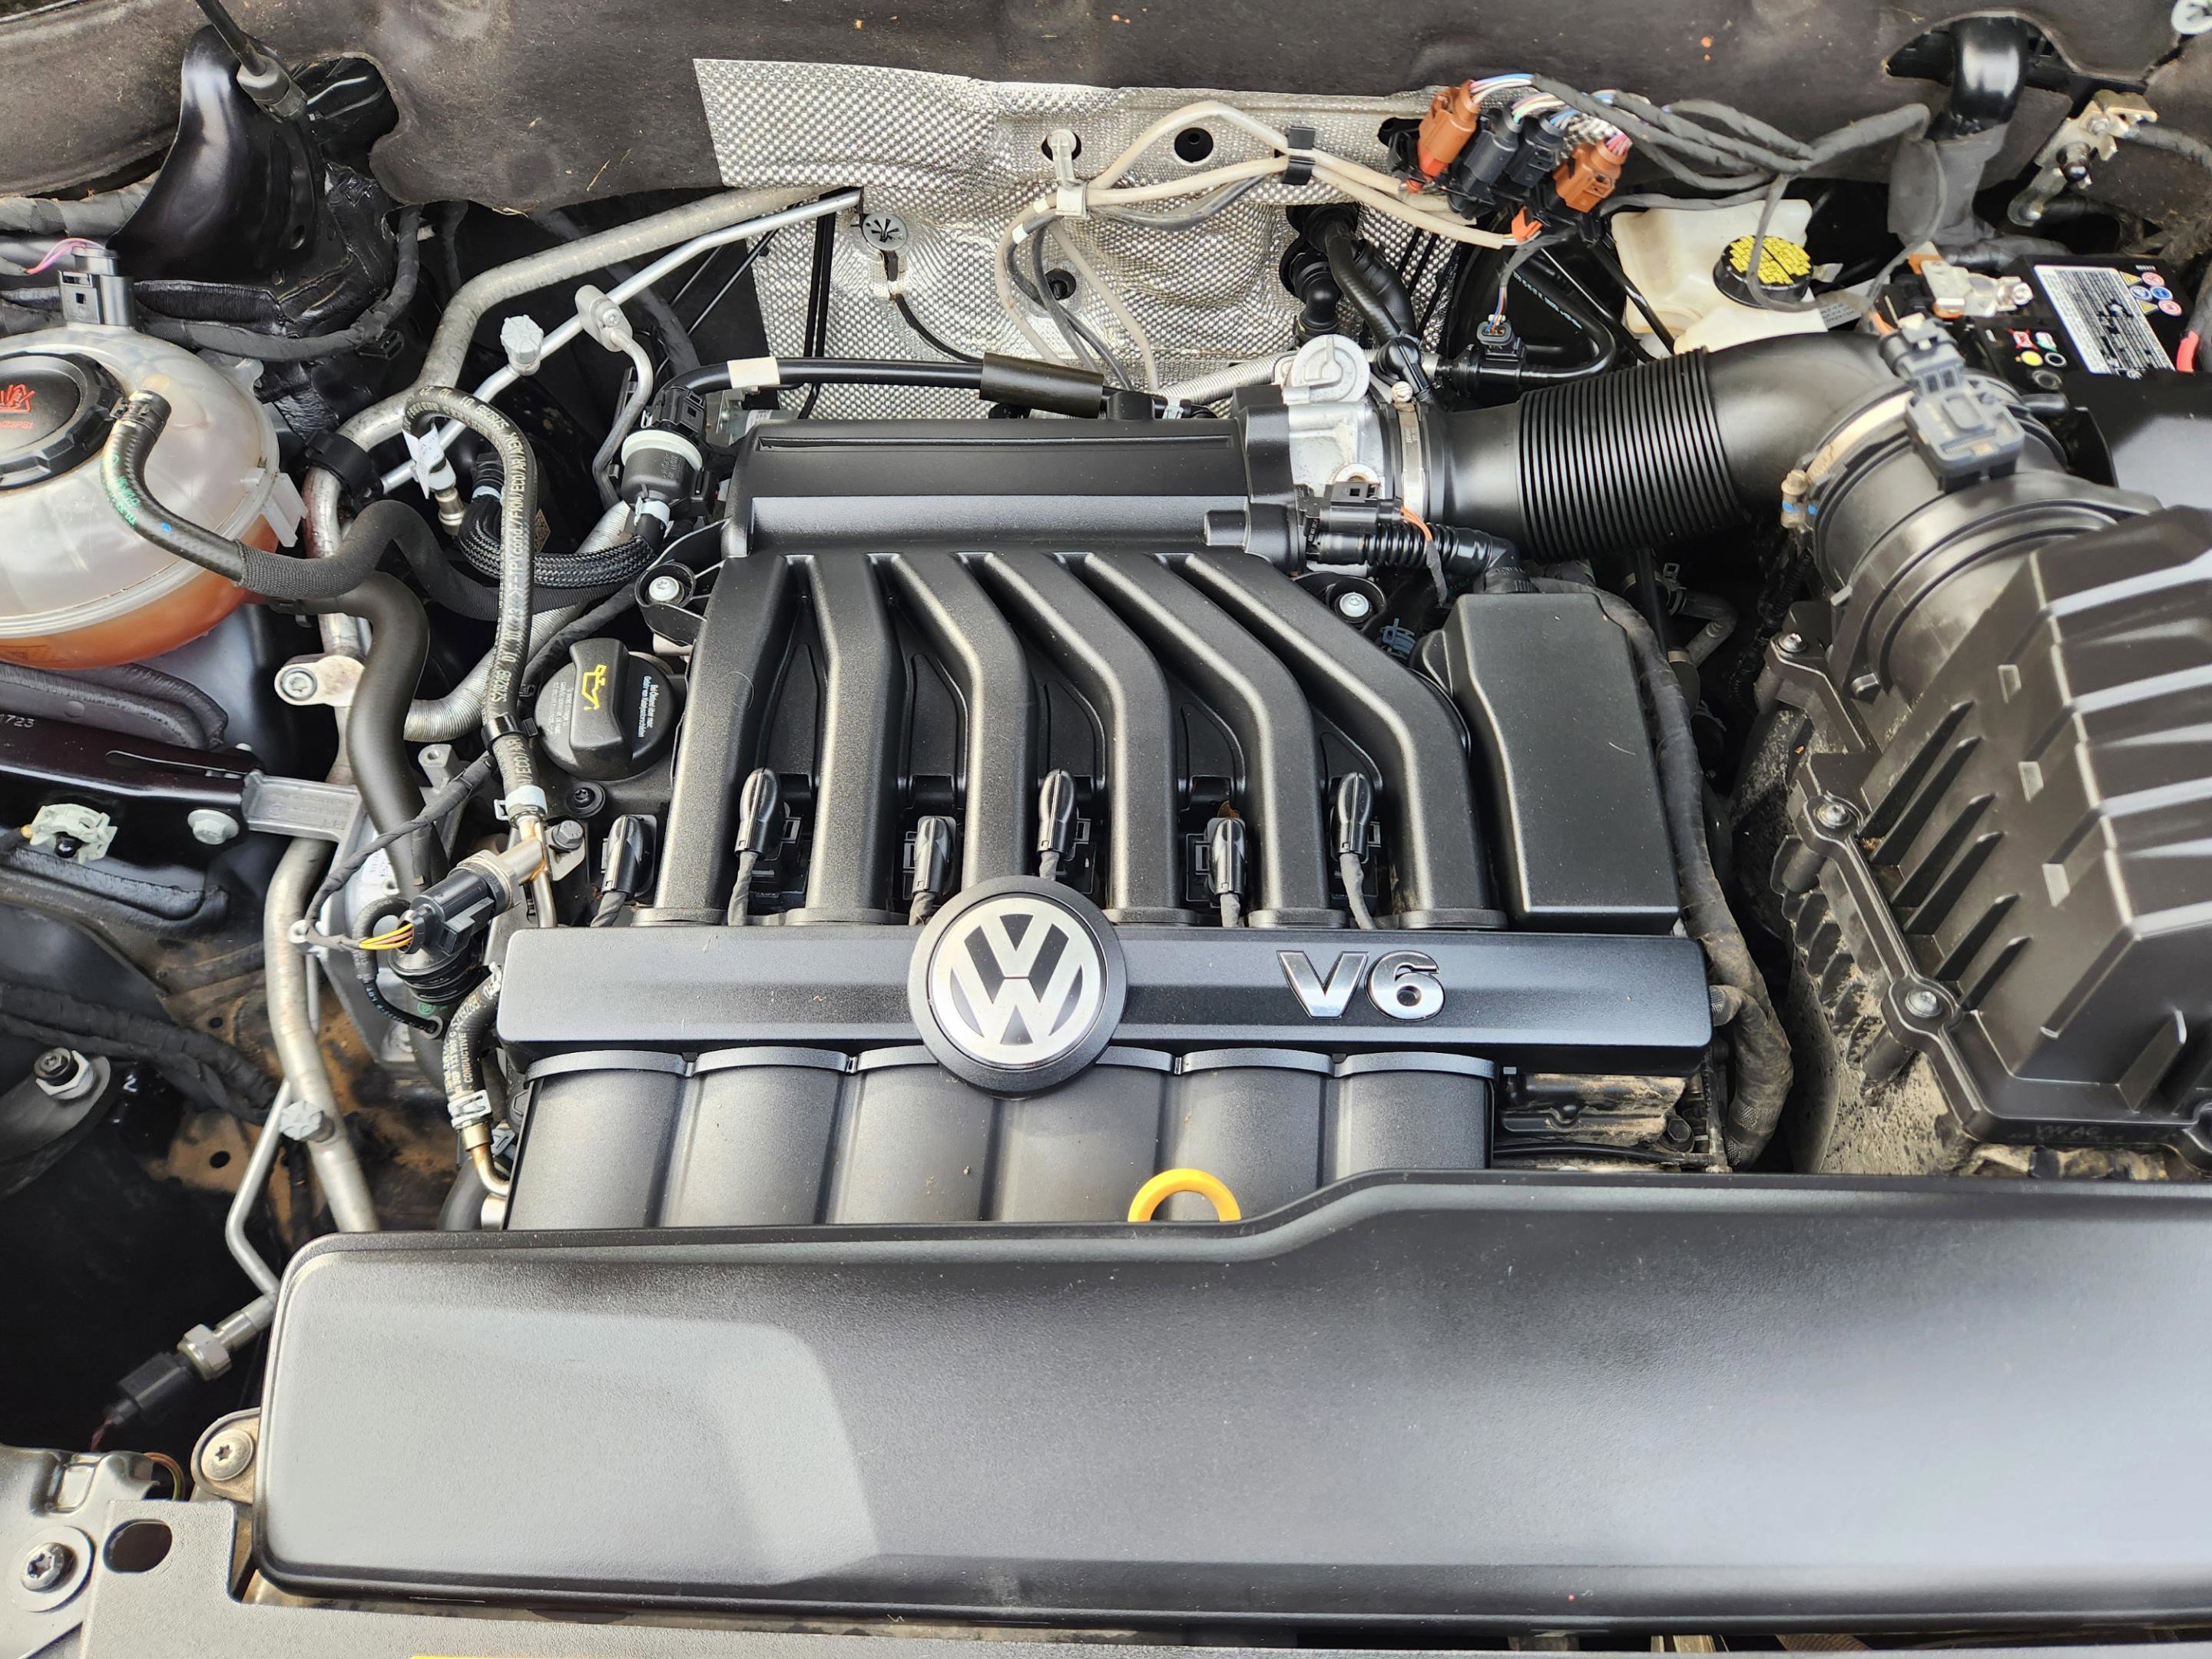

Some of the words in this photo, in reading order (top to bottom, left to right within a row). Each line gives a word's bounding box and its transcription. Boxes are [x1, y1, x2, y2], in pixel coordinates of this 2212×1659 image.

[931, 895, 1104, 1065] VW
[1276, 950, 1447, 1021] V6
[459, 1033, 473, 1083] CONDUCTIVE
